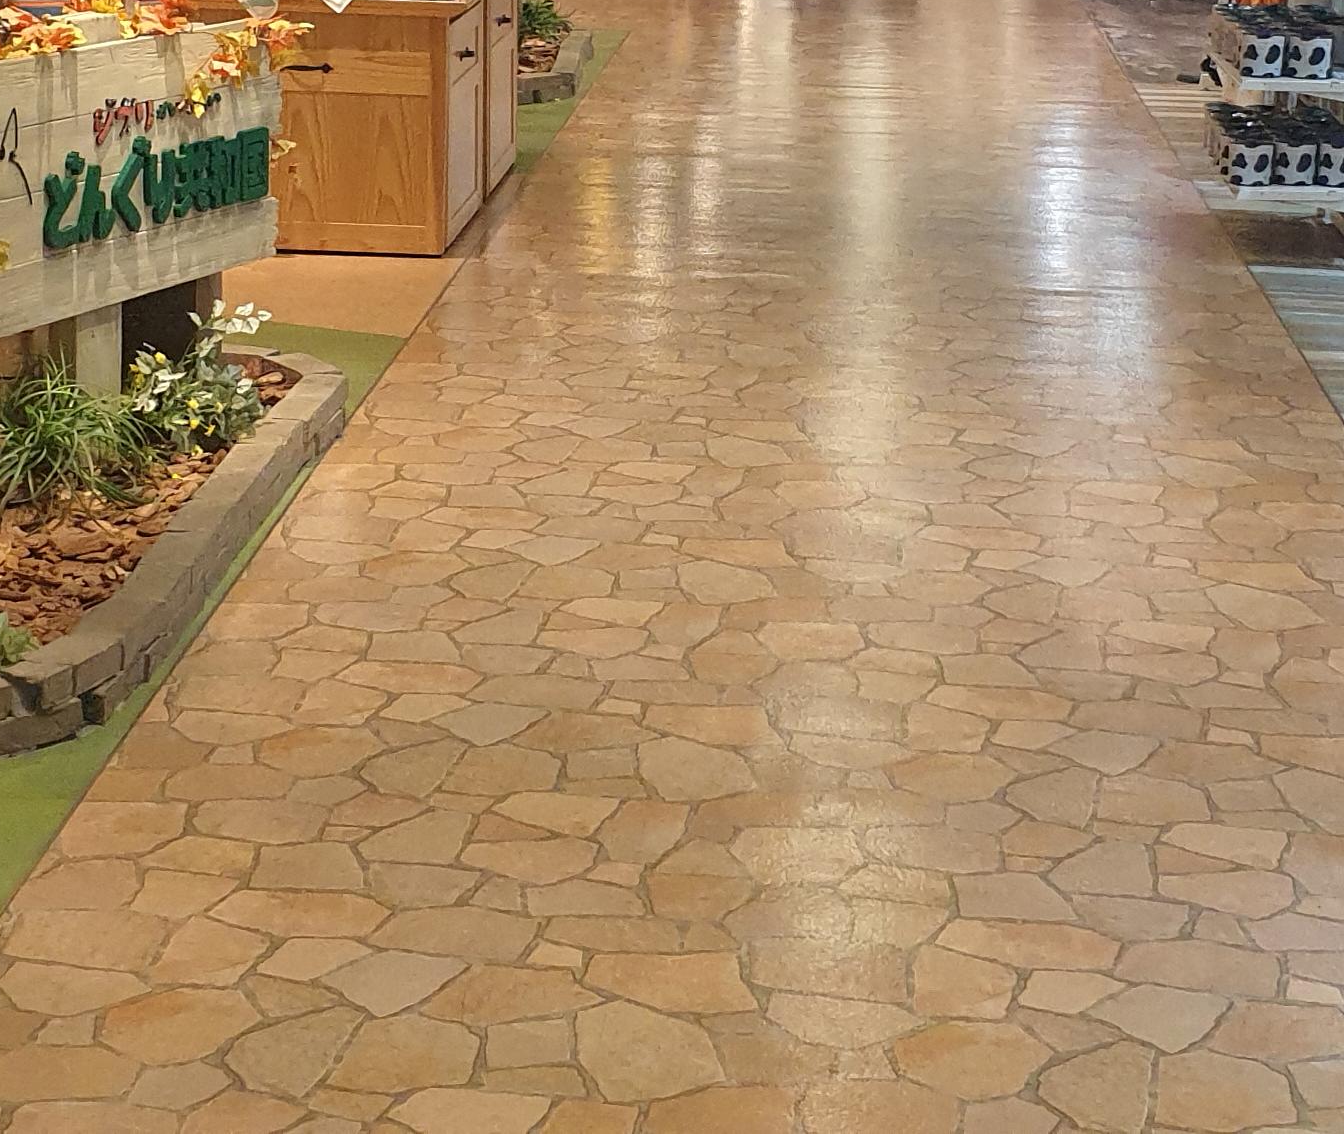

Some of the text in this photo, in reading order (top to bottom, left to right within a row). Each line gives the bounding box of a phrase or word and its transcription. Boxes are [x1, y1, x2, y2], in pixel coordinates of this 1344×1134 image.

[43, 126, 270, 250] どんぐり共和国
